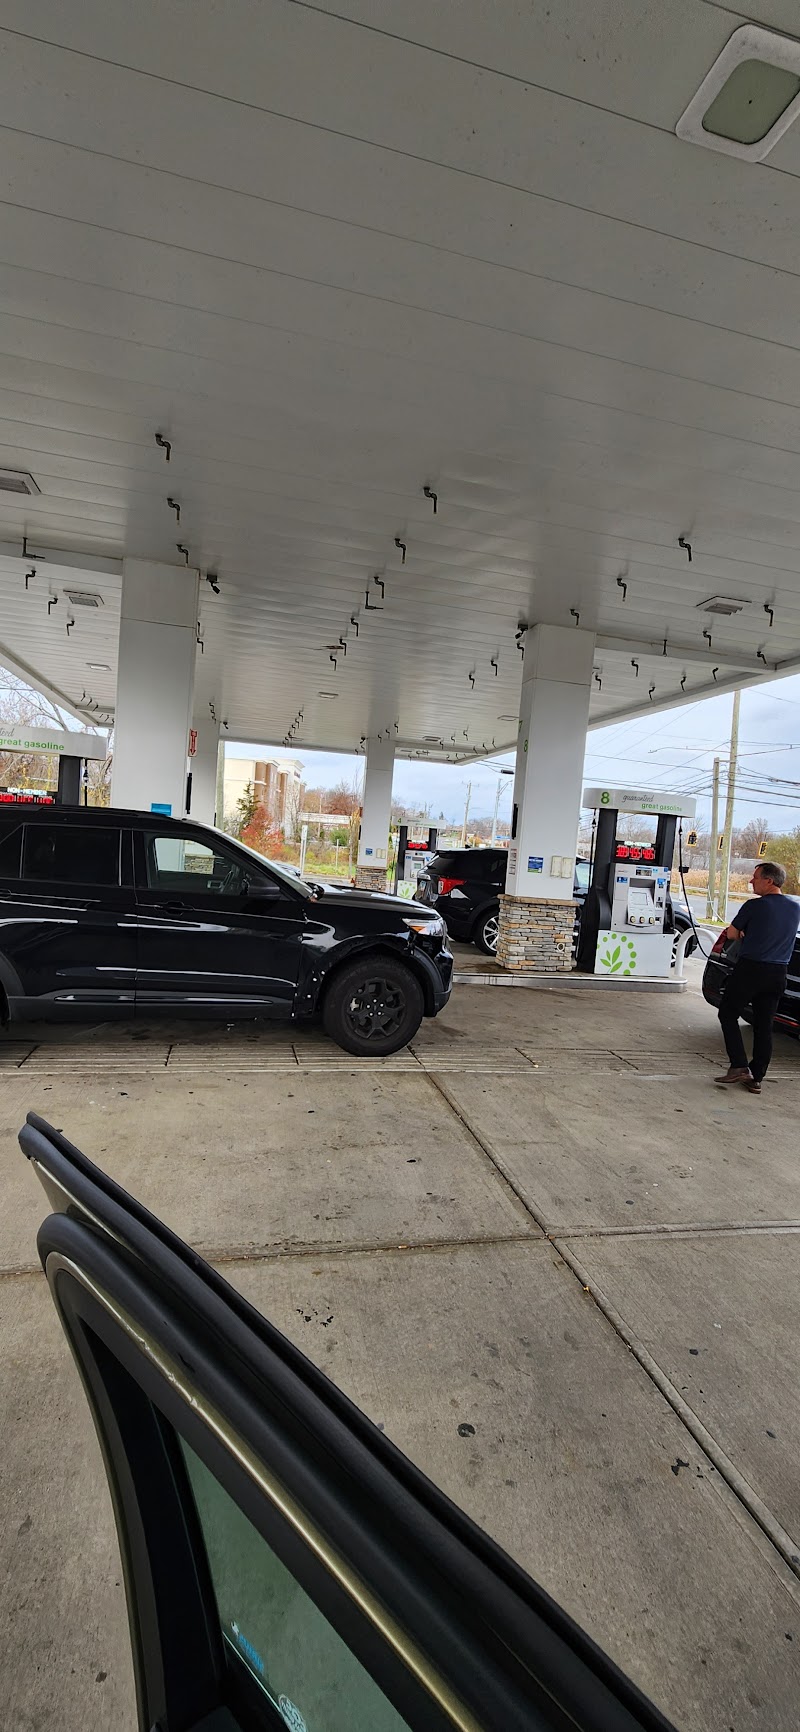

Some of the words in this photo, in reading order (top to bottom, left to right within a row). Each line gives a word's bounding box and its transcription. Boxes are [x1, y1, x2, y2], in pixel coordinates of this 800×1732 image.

[24, 740, 65, 751] gasoline
[523, 739, 529, 753] 8
[600, 791, 610, 805] 8
[659, 804, 683, 812] gasoline
